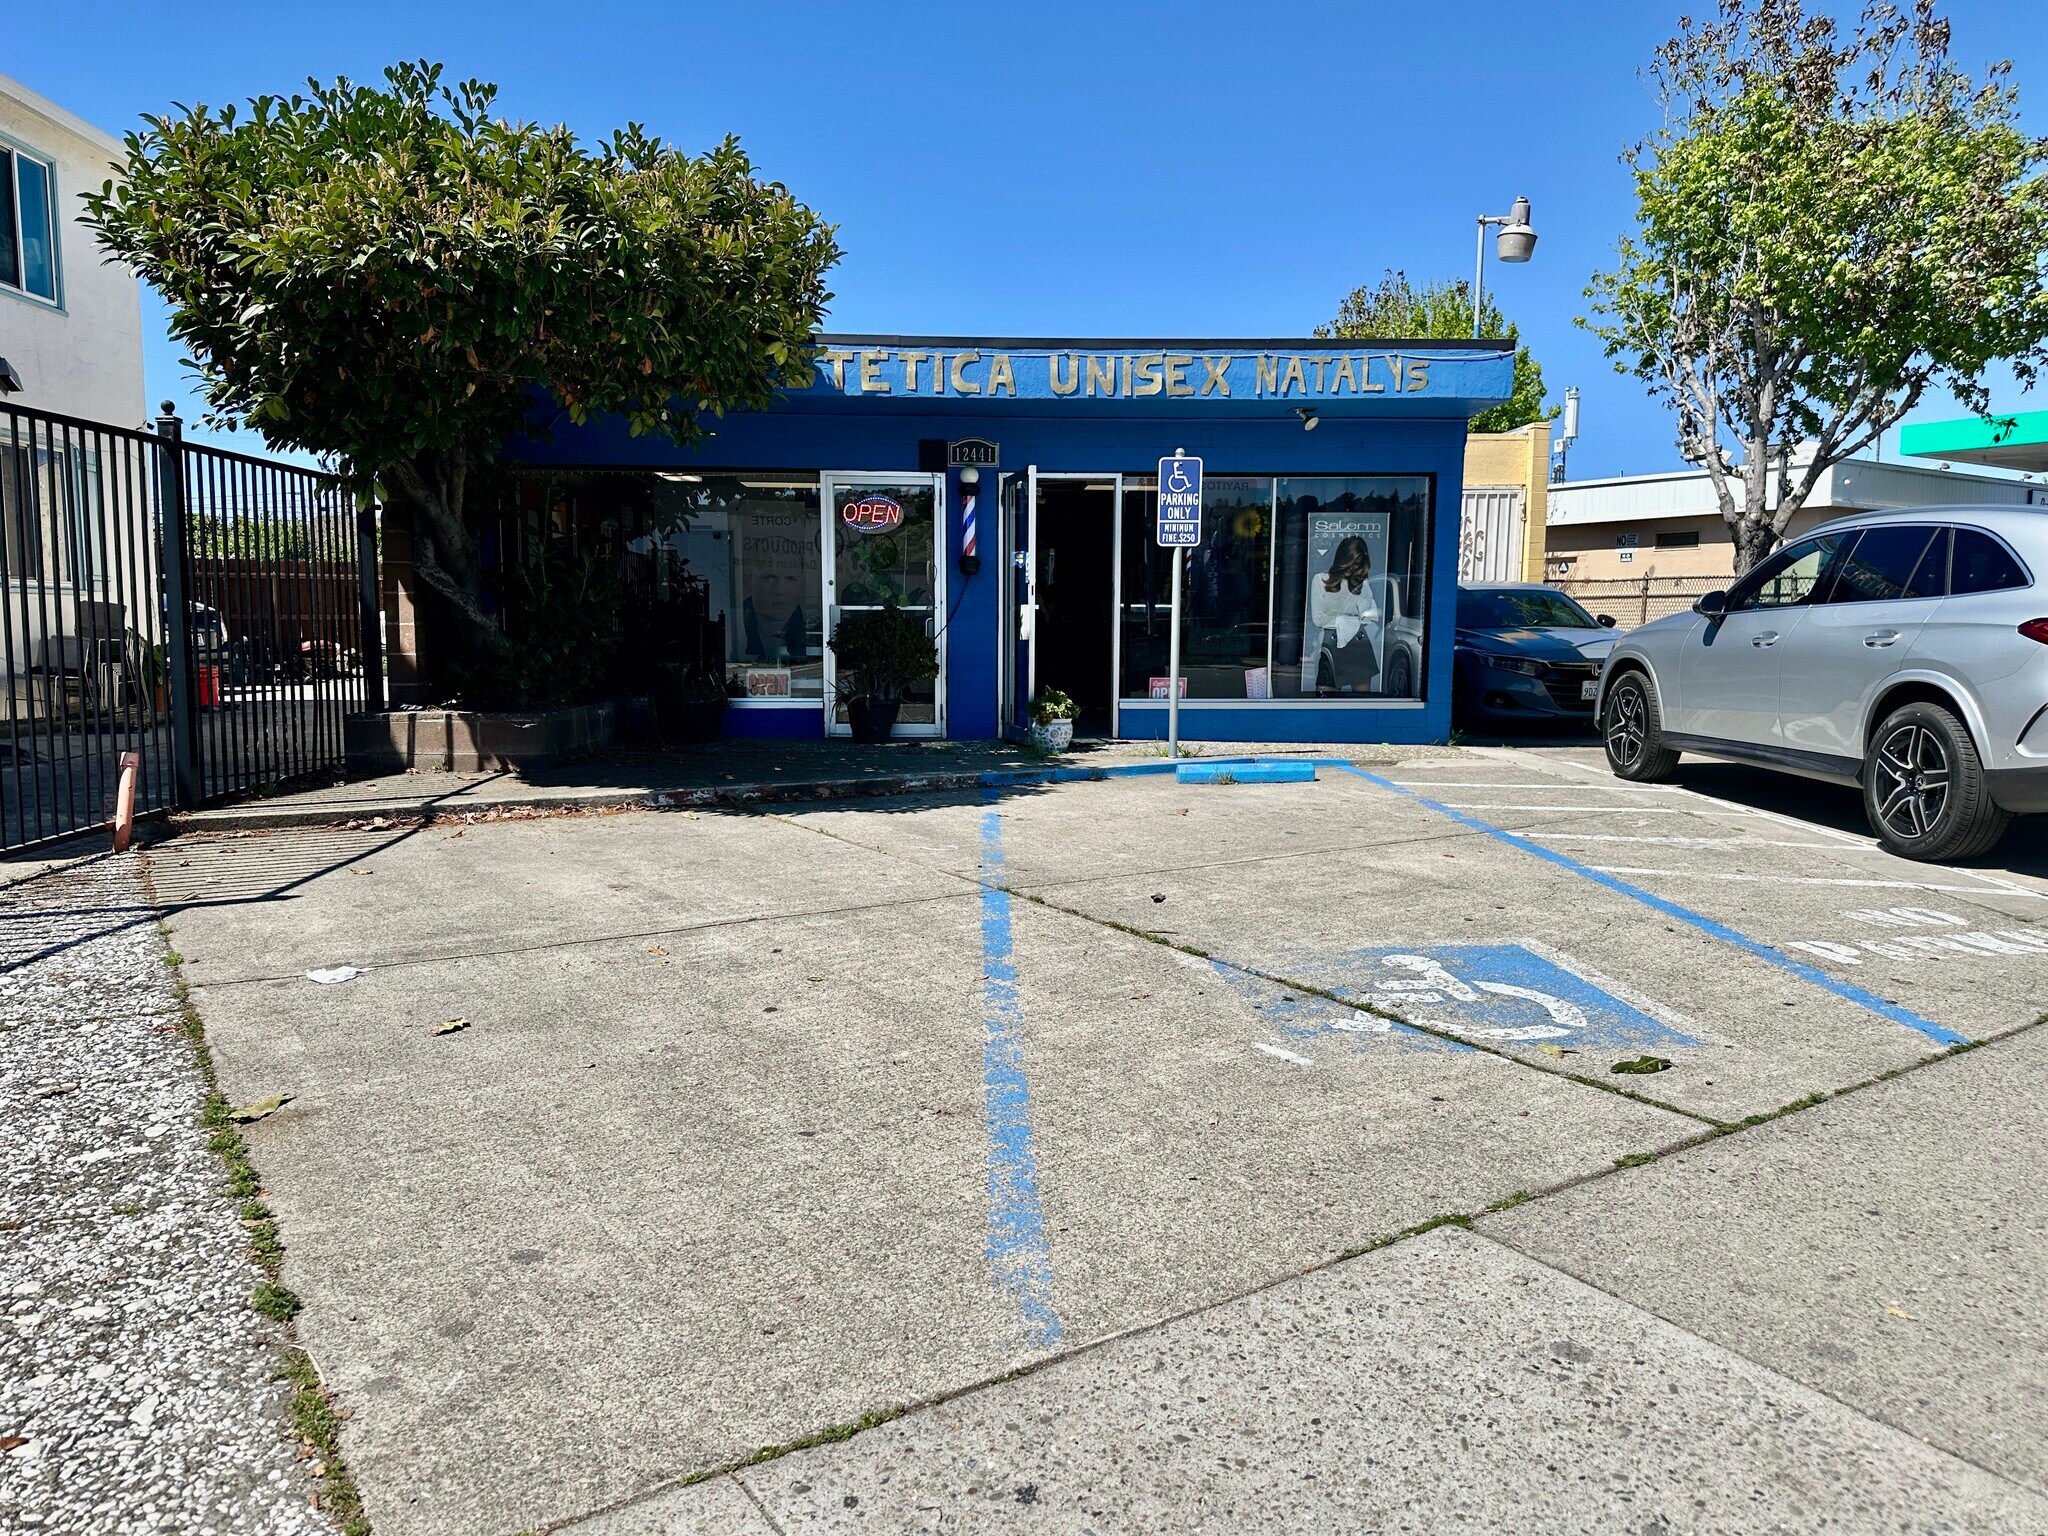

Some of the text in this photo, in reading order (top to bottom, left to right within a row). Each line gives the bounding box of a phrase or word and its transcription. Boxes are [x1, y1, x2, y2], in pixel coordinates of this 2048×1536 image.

[955, 447, 992, 462] 12441
[1160, 493, 1199, 506] PARKING
[843, 503, 900, 524] OPEN
[1167, 506, 1191, 519] ONLY
[1164, 523, 1194, 532] MINIMUM
[1315, 520, 1381, 530] Salerm
[1162, 533, 1195, 543] FINE $250
[1616, 534, 1627, 546] NO
[1152, 687, 1183, 699] OPN
